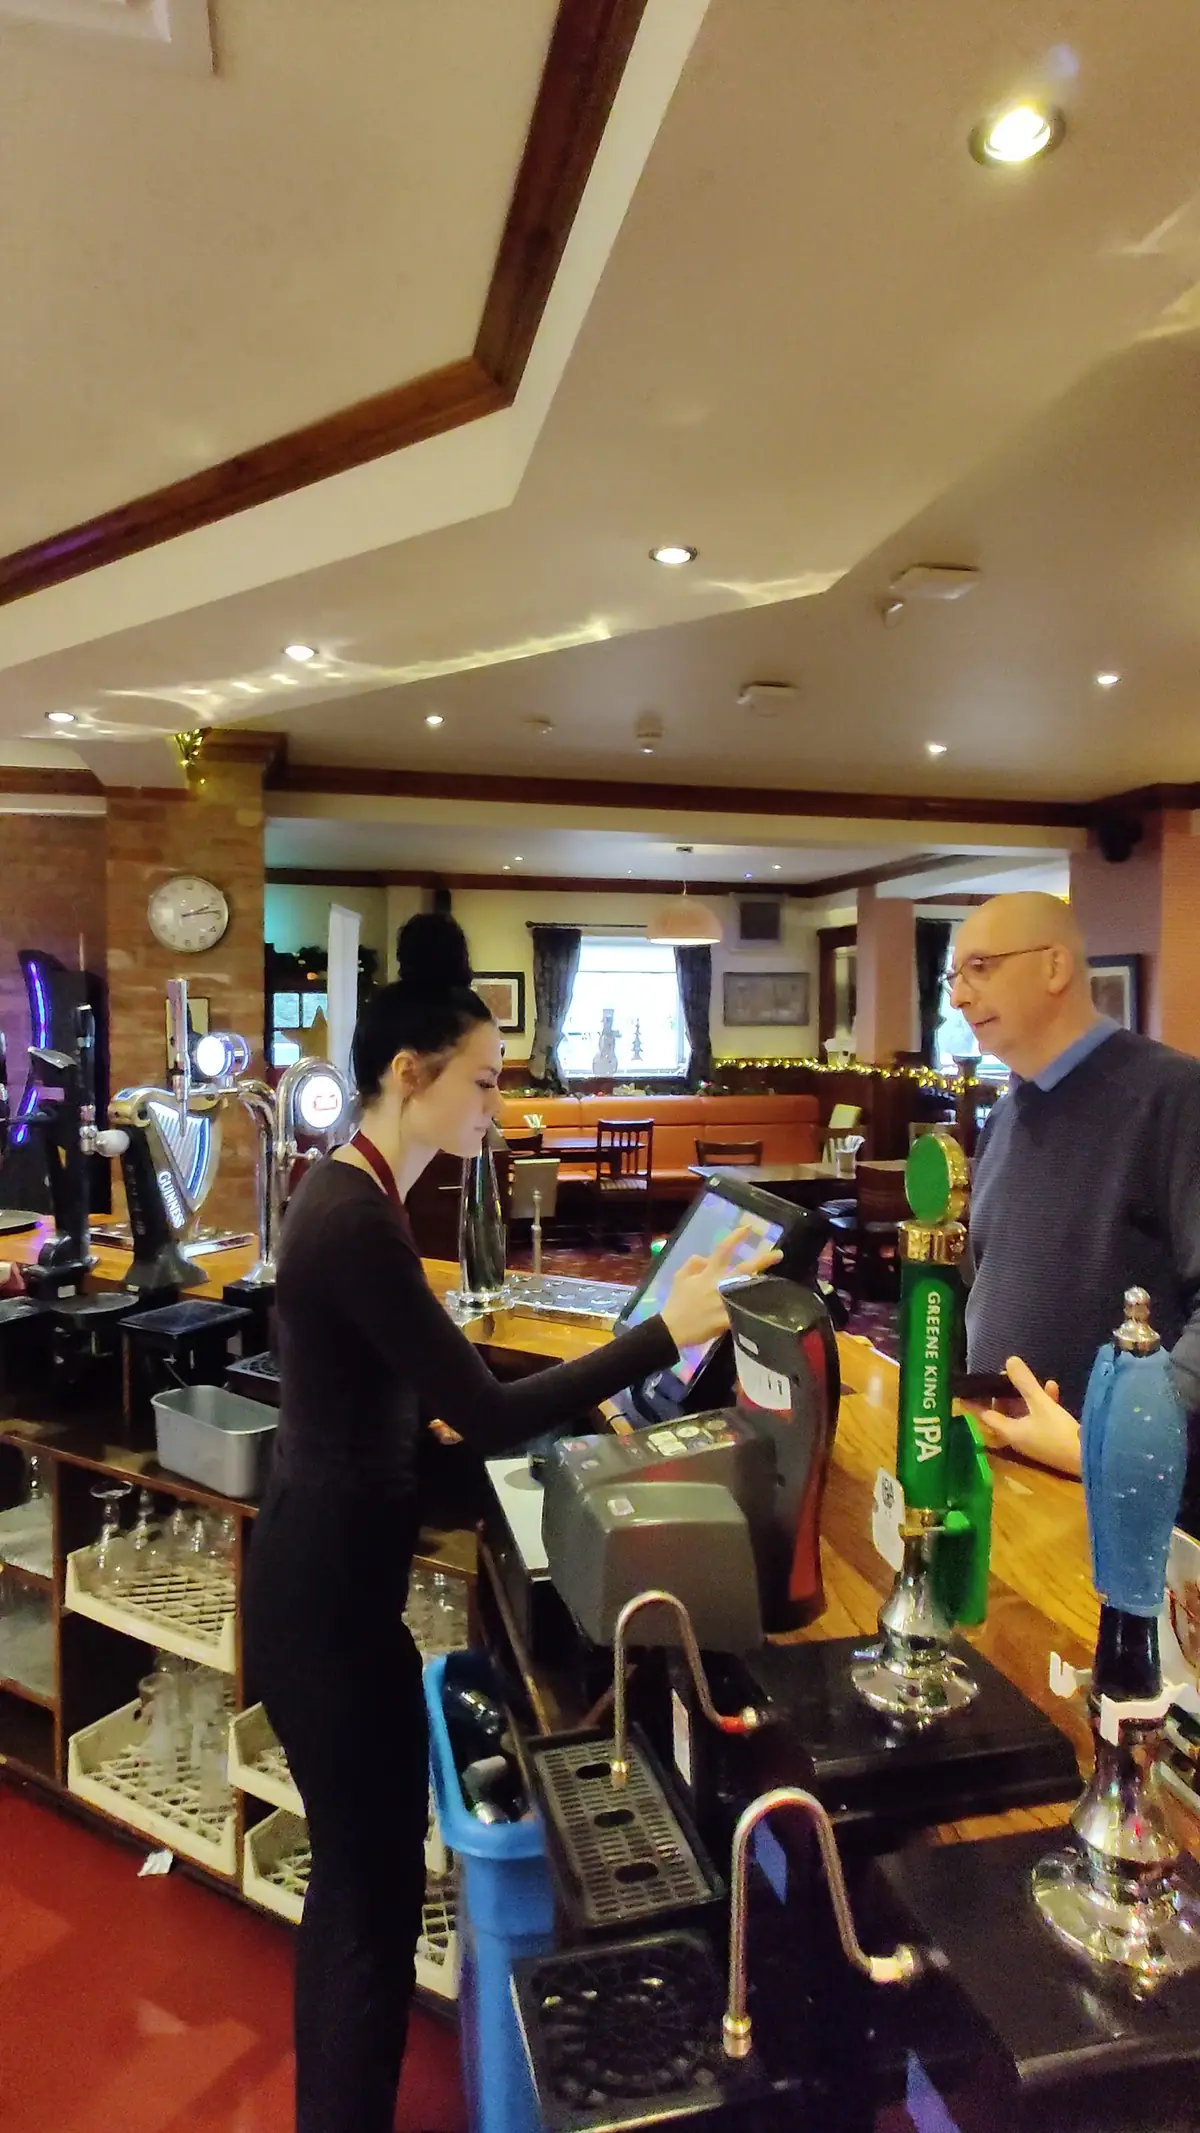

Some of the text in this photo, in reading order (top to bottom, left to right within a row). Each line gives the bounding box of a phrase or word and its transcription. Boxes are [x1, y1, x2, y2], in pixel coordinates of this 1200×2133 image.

[158, 1170, 185, 1229] GUINNESS
[913, 1291, 943, 1463] GREENE KING IPA
